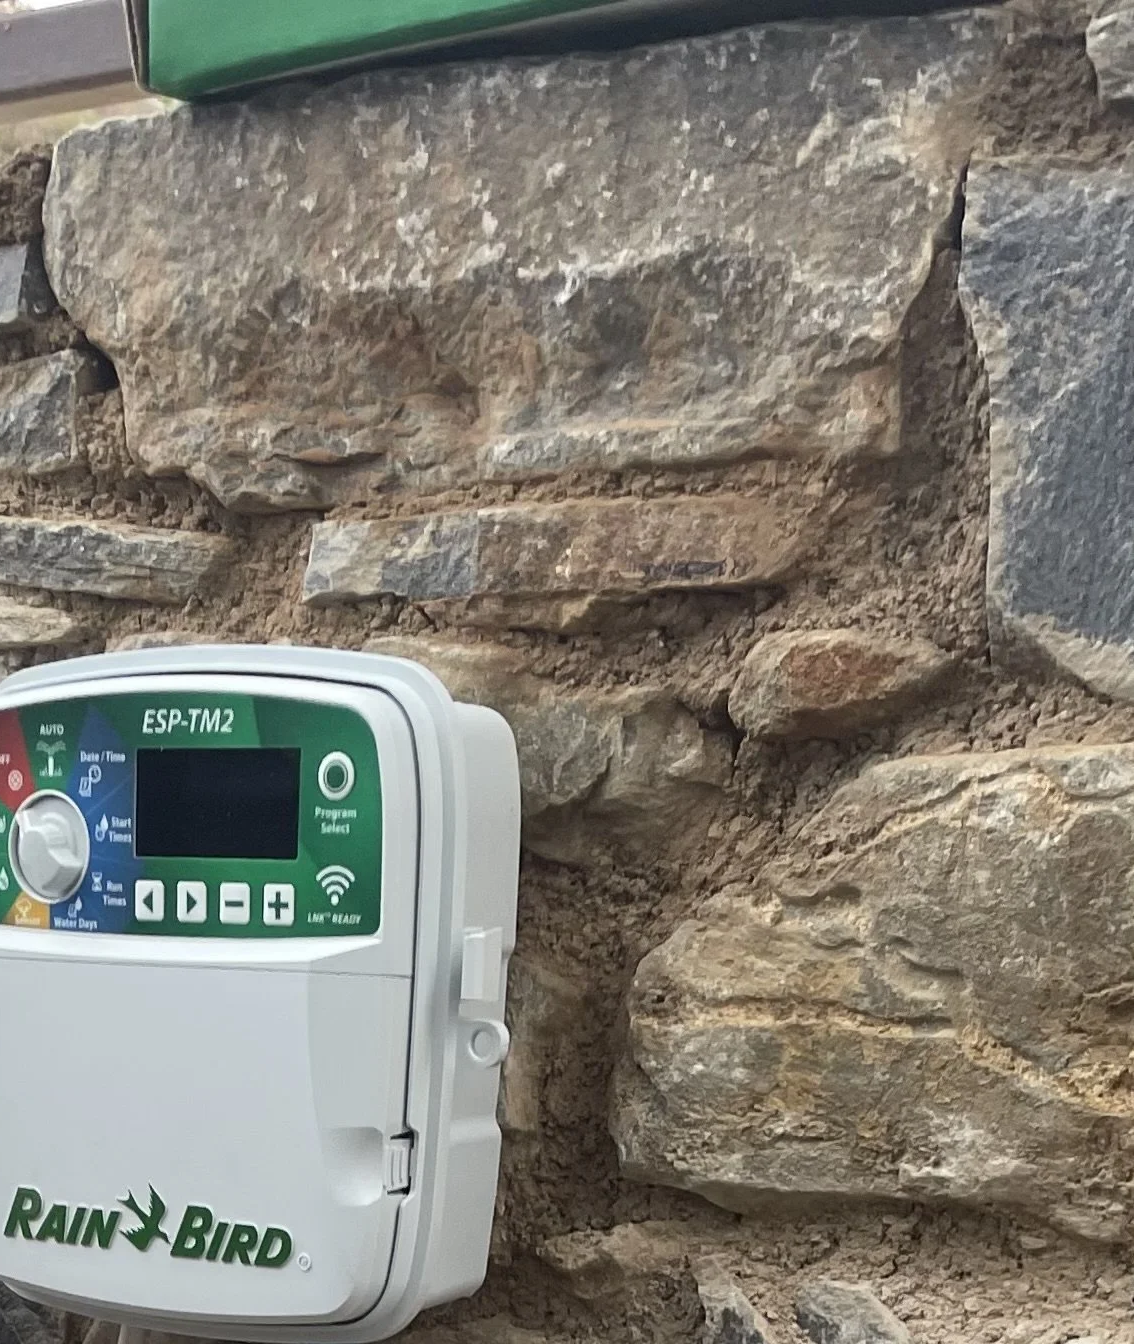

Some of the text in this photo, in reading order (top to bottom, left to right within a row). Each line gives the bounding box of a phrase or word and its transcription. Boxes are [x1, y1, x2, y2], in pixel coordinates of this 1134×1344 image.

[142, 708, 234, 734] ESP-TM2
[39, 723, 64, 735] AUTO
[80, 751, 100, 762] Date
[106, 751, 126, 762] Time
[315, 806, 357, 823] Program
[111, 816, 131, 828] Start
[321, 822, 350, 834] Select
[108, 831, 132, 843] Times
[106, 880, 123, 893] Run
[103, 894, 126, 906] Times
[53, 917, 98, 930] Water Days
[332, 913, 362, 925] READY
[3, 1186, 294, 1268] RAIN BIRD
